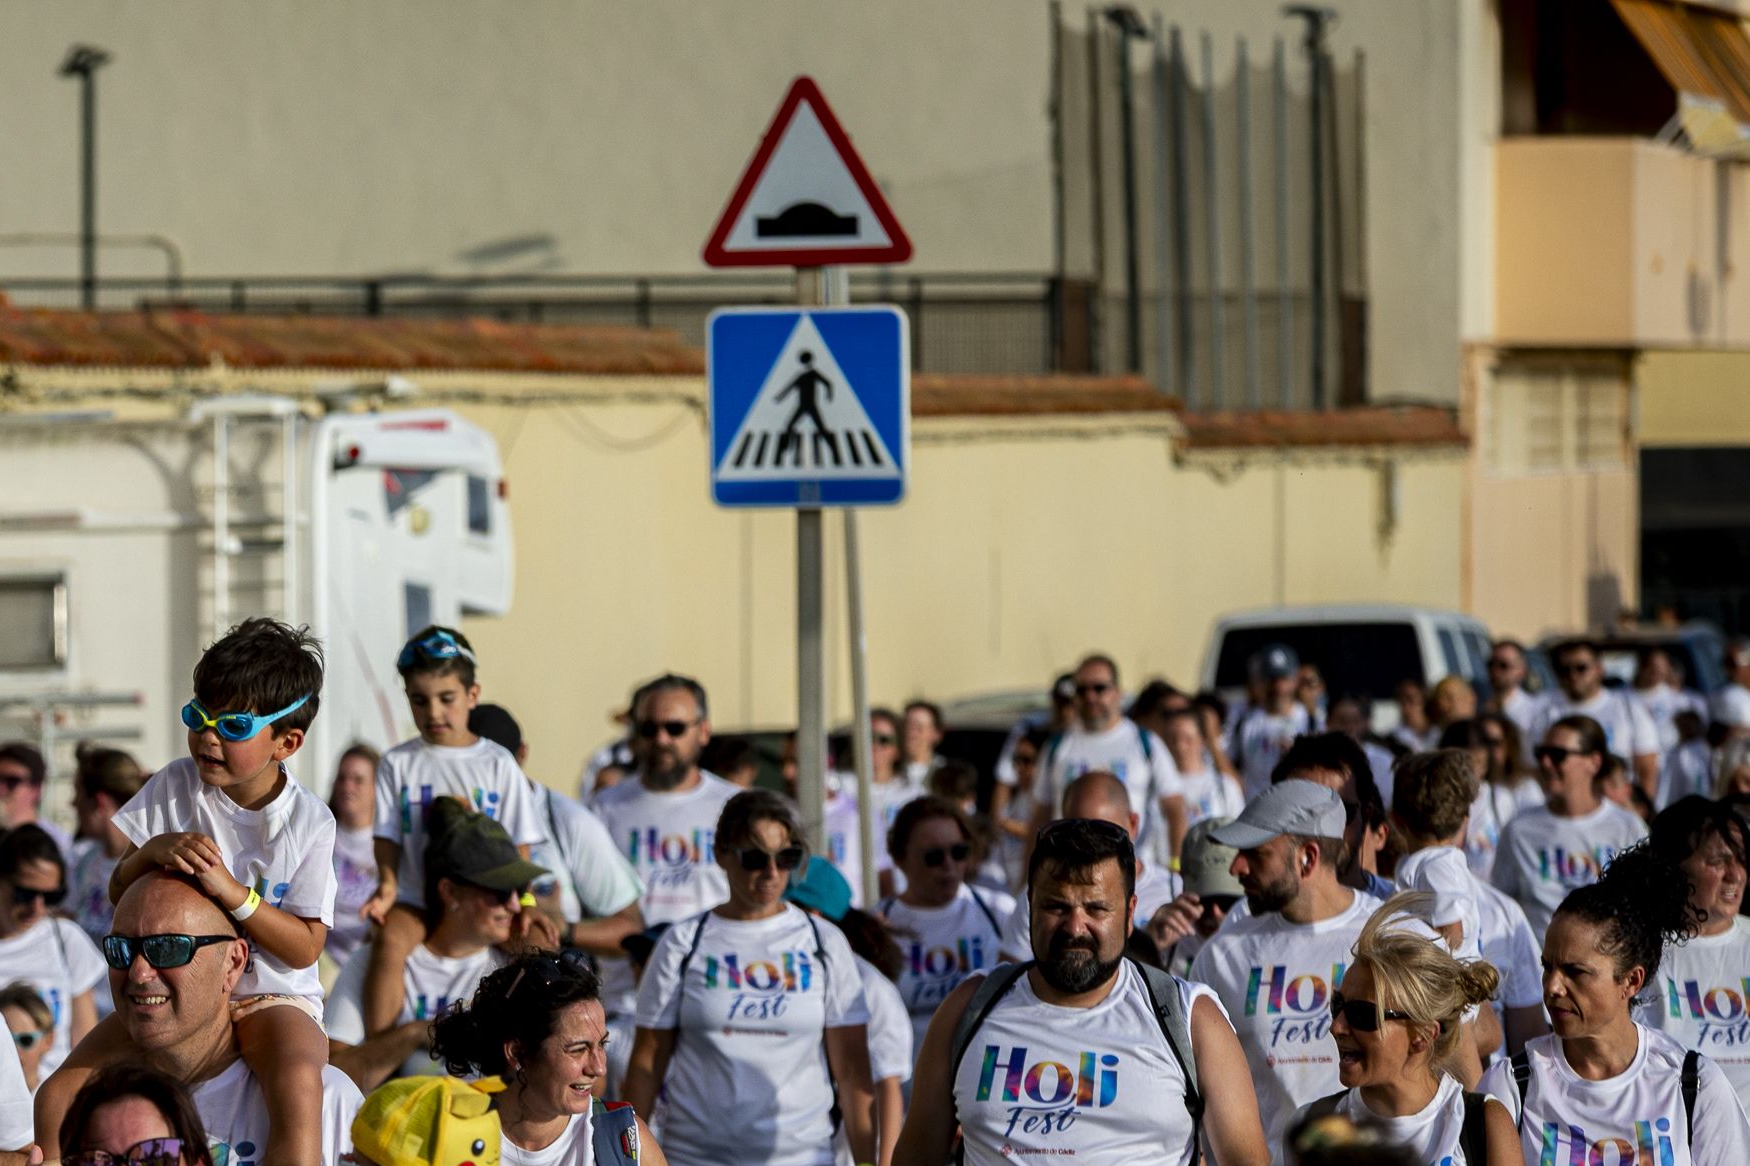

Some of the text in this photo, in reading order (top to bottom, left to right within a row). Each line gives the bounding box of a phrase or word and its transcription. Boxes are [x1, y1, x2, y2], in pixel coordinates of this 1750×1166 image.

[630, 828, 717, 867] Holi
[705, 952, 811, 993] Holi
[1245, 963, 1347, 1017] Hol
[728, 992, 791, 1021] Fest
[1666, 976, 1750, 1022] Hol
[1271, 1014, 1331, 1047] Fest
[976, 1044, 1119, 1109] Holi
[1005, 1106, 1081, 1138] Fest
